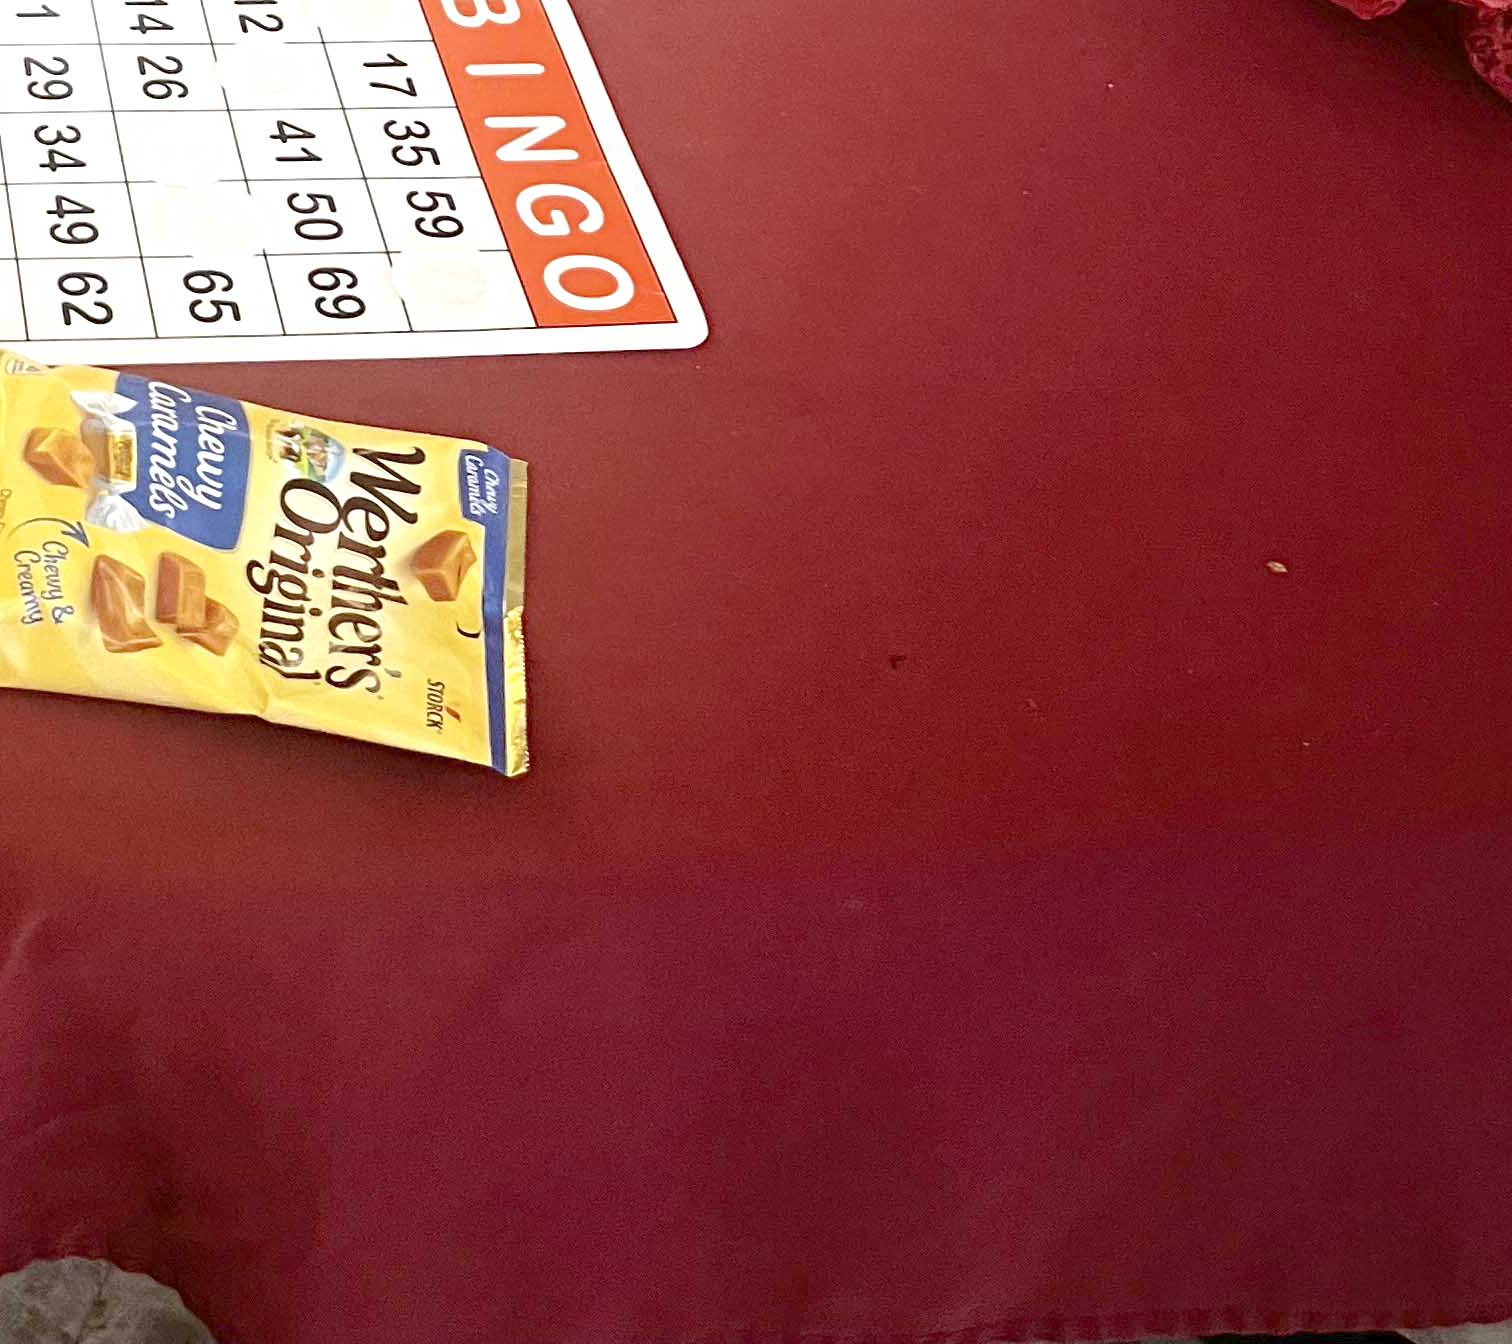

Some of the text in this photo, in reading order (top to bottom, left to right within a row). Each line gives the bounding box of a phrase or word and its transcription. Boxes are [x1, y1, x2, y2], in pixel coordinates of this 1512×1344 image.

[15, 3, 114, 327] 1 29 34 49 62
[268, 119, 324, 163] 41
[362, 52, 465, 239] 17 35 59
[136, 55, 190, 101] 26
[182, 269, 242, 324] 65
[286, 192, 344, 241] 50
[307, 266, 367, 320] 69
[146, 380, 191, 521] Caramels
[179, 404, 238, 511] Chewy
[464, 452, 486, 518] Caramels
[481, 467, 500, 515] Chewy
[14, 549, 44, 625] Creamy
[38, 541, 75, 625] Chewy &
[247, 478, 340, 682] Original
[324, 446, 425, 696] Werther's
[425, 678, 442, 729] STORCK
